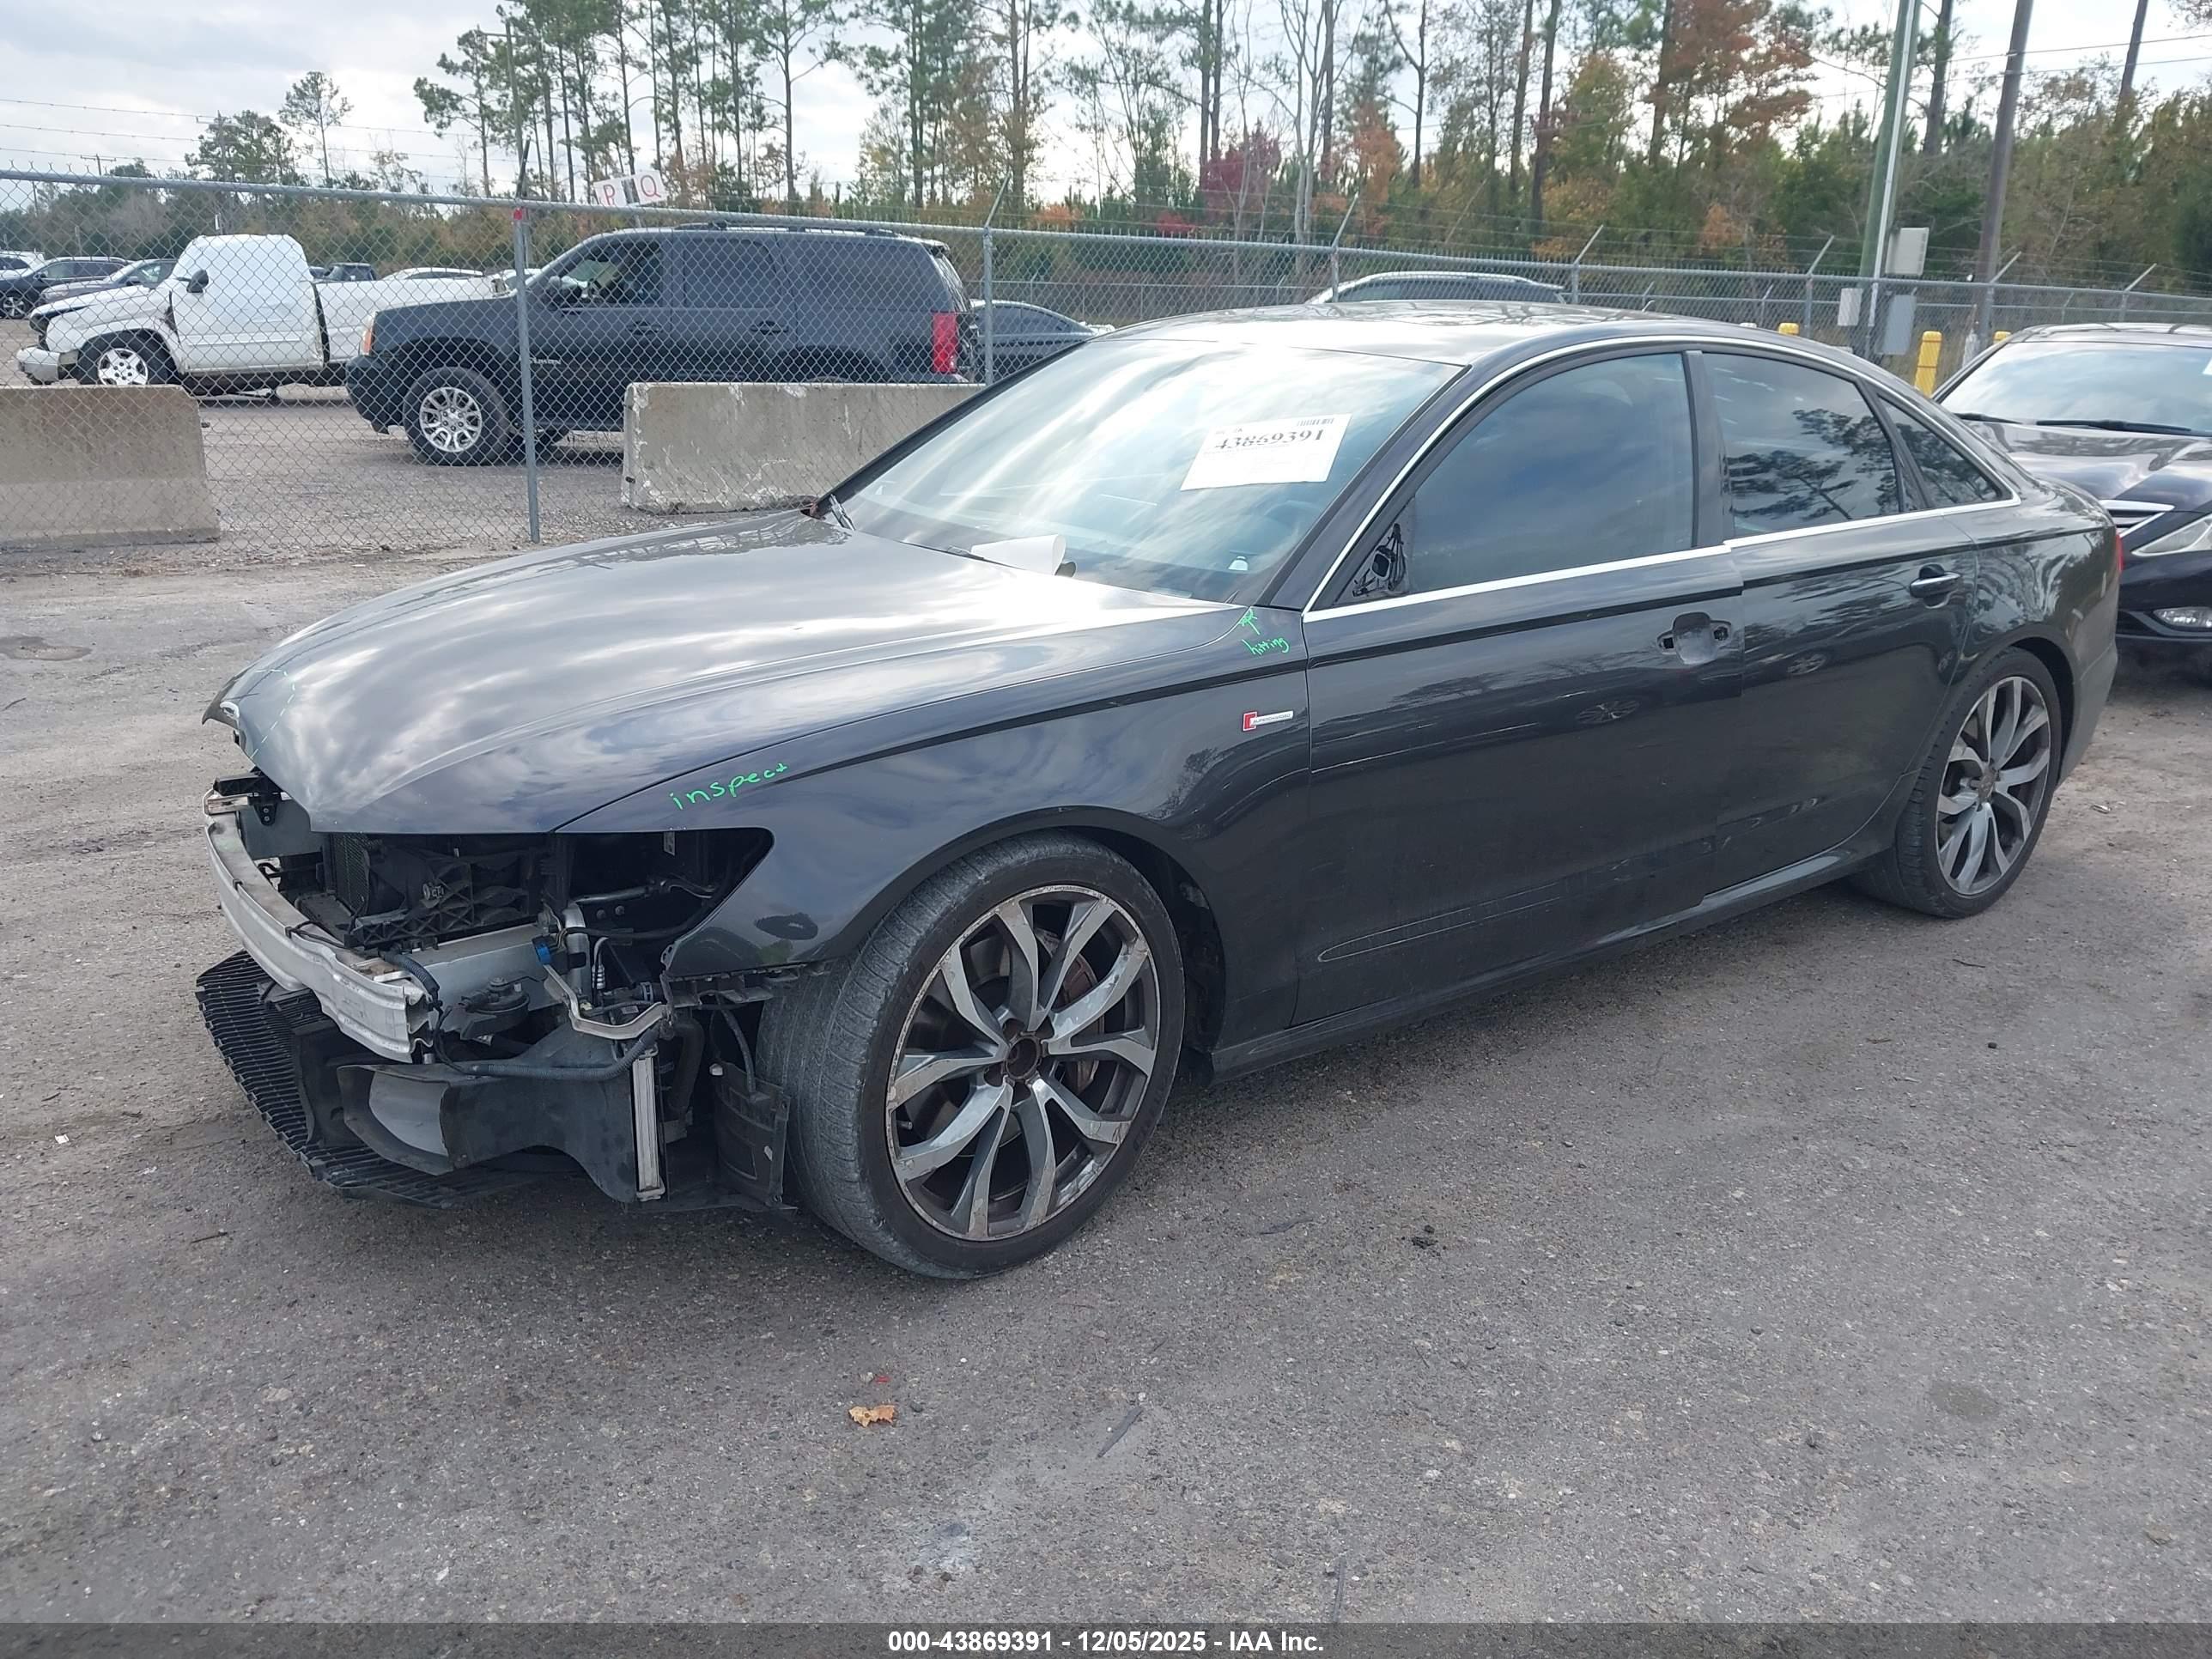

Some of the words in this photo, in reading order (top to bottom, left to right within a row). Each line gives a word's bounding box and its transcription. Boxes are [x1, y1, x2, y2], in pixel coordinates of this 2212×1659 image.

[641, 174, 661, 198] Q
[1214, 429, 1324, 450] 43869391
[670, 763, 787, 810] inspect
